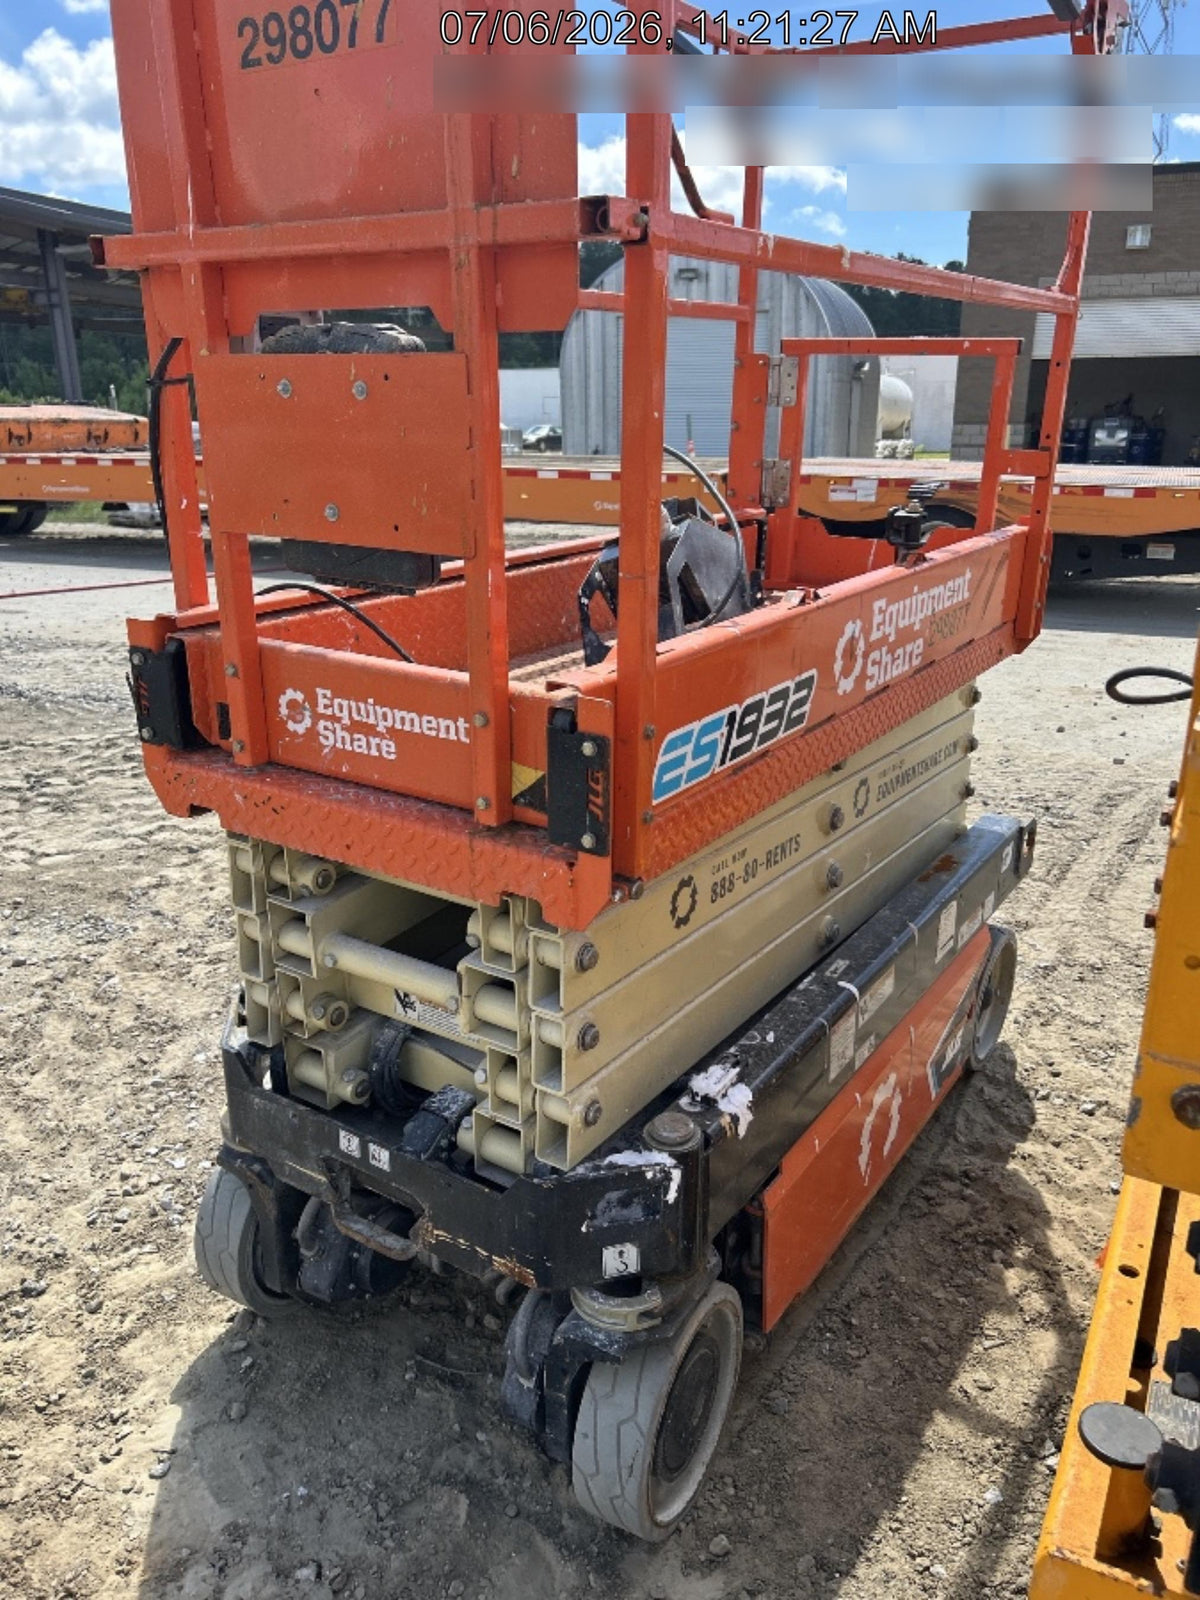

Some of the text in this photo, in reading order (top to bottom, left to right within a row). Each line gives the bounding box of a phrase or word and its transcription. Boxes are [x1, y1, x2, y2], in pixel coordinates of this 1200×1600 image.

[237, 0, 391, 69] 298077
[869, 568, 972, 642] Equipment
[865, 638, 924, 691] Share
[315, 687, 470, 743] Equipment
[318, 719, 397, 760] Share
[652, 669, 817, 805] ES1932
[588, 768, 605, 822] JLG
